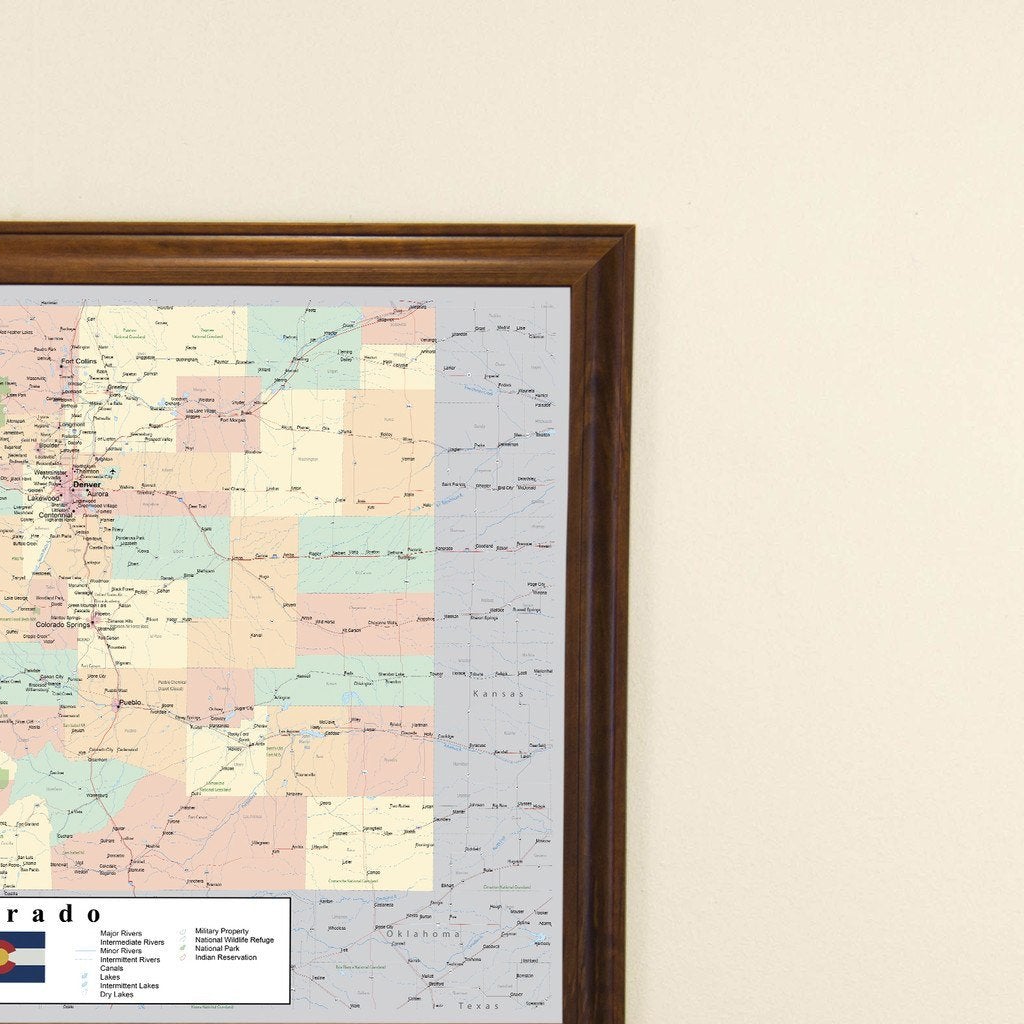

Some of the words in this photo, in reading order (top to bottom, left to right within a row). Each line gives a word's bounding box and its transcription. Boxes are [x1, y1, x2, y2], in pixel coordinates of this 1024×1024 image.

[101, 929, 119, 939] Major
[121, 929, 142, 937] Rivers
[195, 927, 218, 936] Military
[221, 927, 249, 936] Property
[386, 930, 460, 938] Oklahoma
[144, 938, 164, 946] Rivers
[195, 936, 222, 944] National
[224, 936, 248, 944] Wildlife
[250, 936, 274, 945] Refuge
[100, 947, 119, 955] Minor
[121, 947, 142, 955] Rivers
[195, 944, 223, 952] National
[225, 944, 239, 952] Park
[101, 956, 137, 964] Intermittent
[139, 956, 160, 964] Rivers
[196, 953, 215, 961] Indian
[218, 953, 257, 961] Reservation
[100, 964, 123, 972] Canals
[100, 973, 120, 981] Lakes
[100, 982, 137, 990] Intermittent
[139, 982, 159, 990] Lakes
[100, 990, 112, 999] Dry
[114, 990, 134, 999] Lakes
[459, 1002, 499, 1010] Texas
